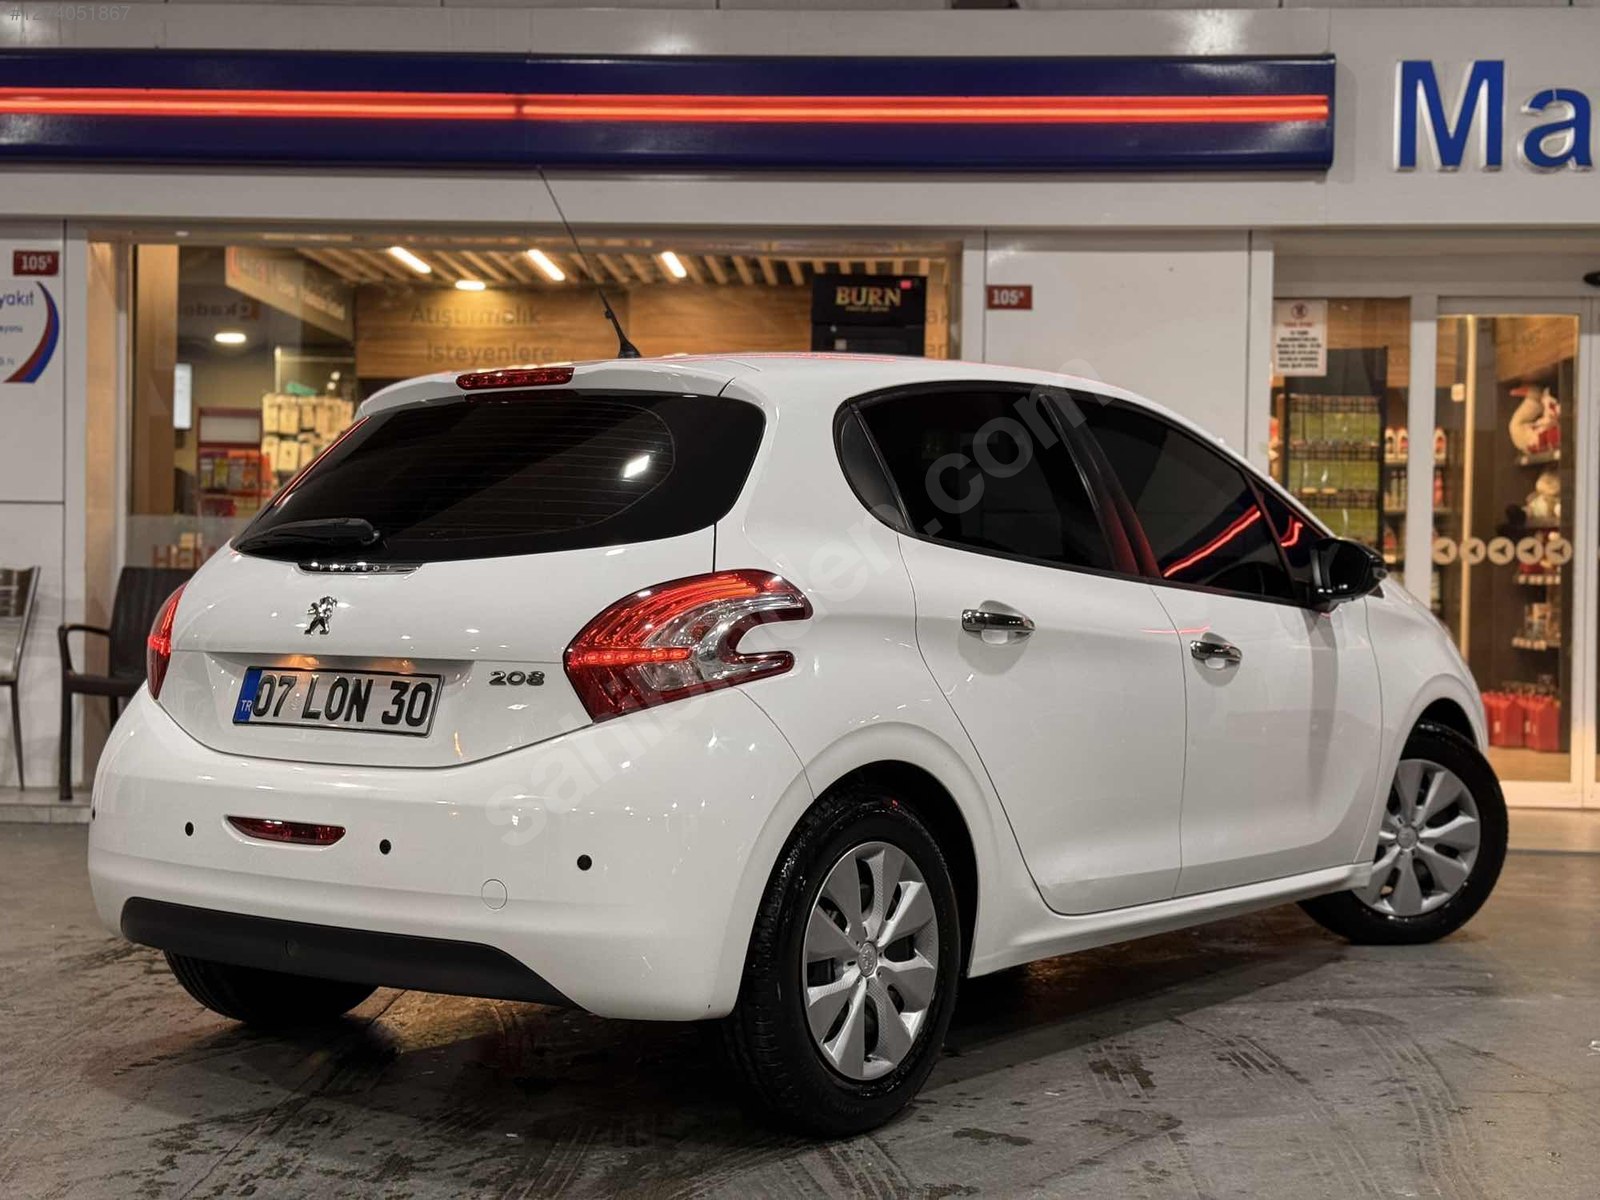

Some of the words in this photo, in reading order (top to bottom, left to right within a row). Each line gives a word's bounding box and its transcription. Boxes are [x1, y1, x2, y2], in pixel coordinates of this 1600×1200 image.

[1395, 59, 1593, 174] Ma
[835, 286, 902, 307] BURN
[488, 670, 546, 687] 208
[240, 699, 253, 713] TR
[252, 674, 298, 718] 07
[301, 673, 375, 723] LON
[381, 680, 433, 728] 30
